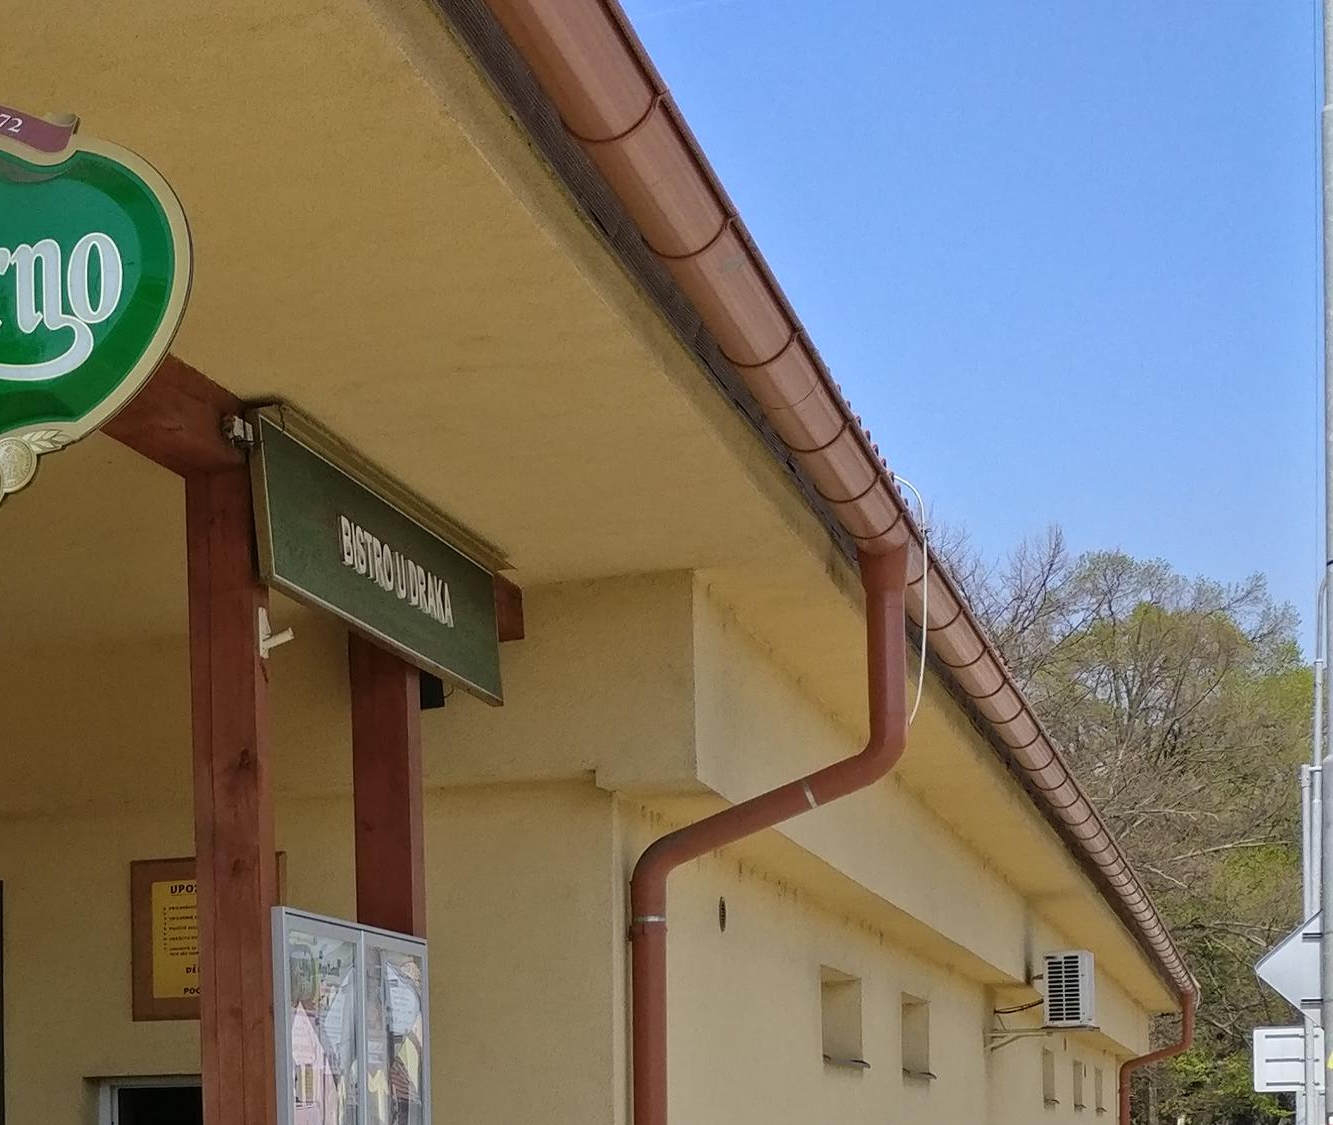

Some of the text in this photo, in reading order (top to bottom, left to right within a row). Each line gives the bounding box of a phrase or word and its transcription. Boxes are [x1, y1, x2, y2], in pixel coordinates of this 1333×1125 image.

[340, 514, 455, 628] BISTRO U DRAKA
